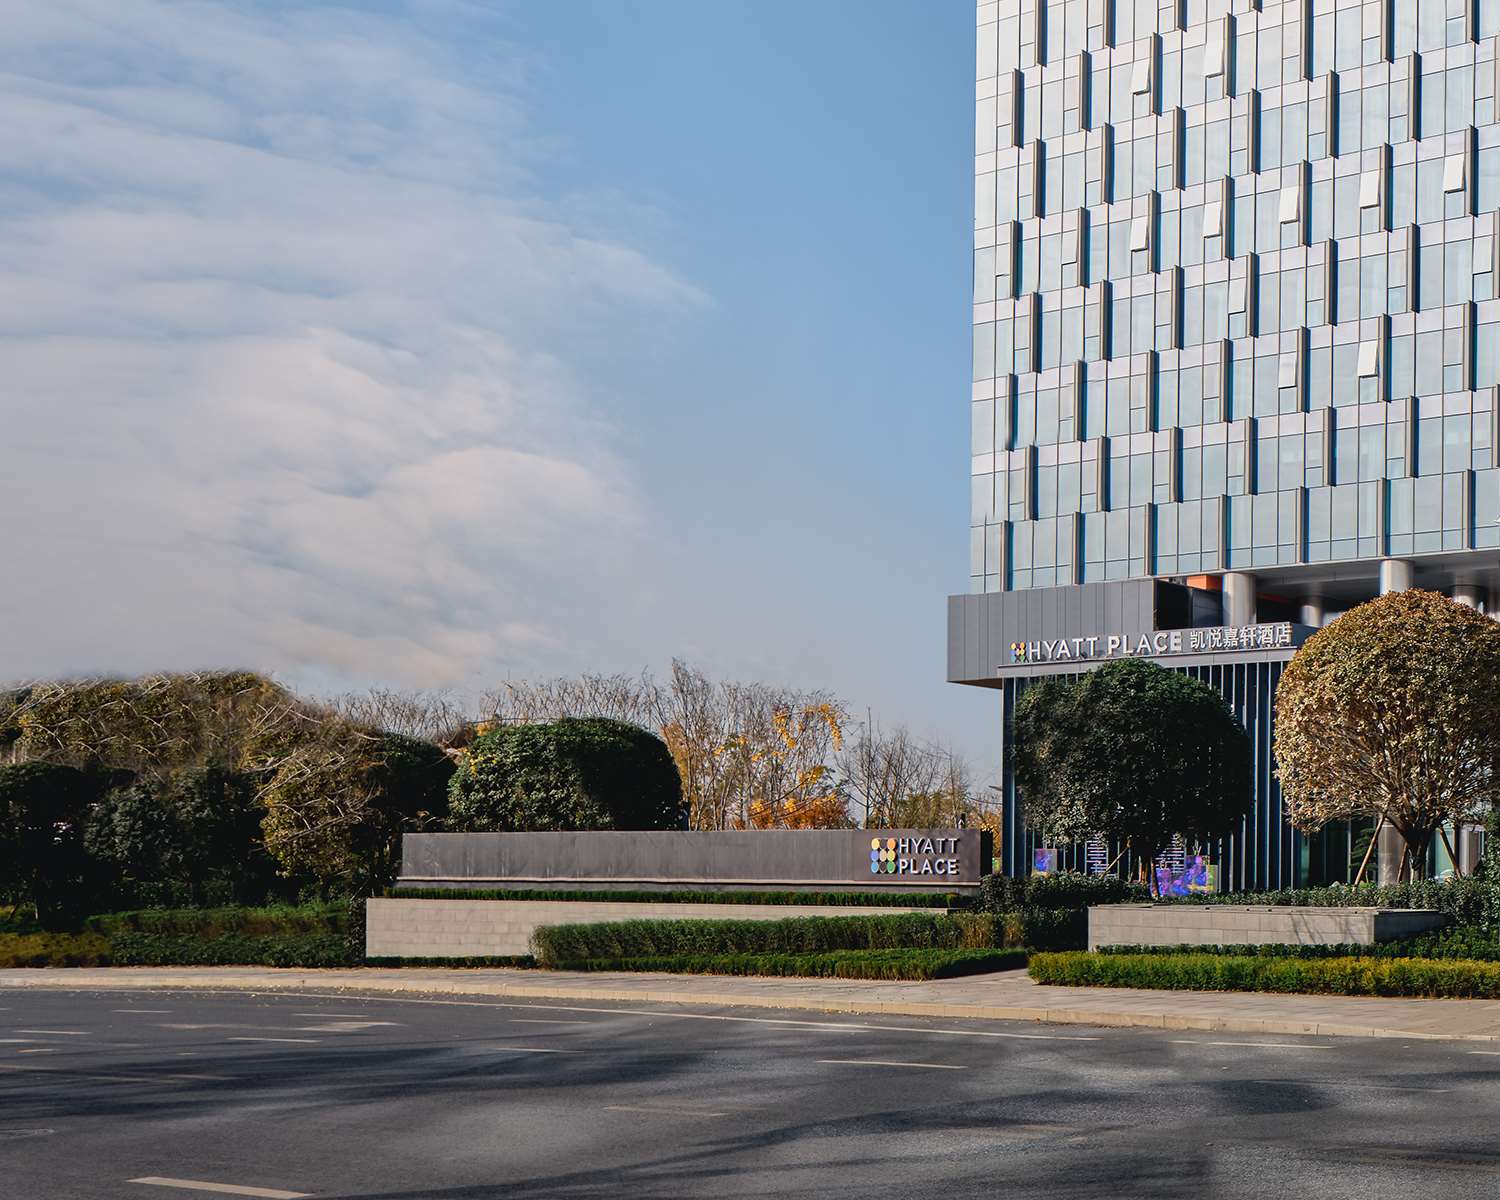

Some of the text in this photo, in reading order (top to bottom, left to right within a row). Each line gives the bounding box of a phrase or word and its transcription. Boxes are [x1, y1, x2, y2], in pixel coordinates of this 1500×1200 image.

[1028, 623, 1291, 660] HYATT PLACE 凯悦嘉轩酒店
[899, 838, 958, 854] HYATT
[899, 858, 958, 875] PLACE
